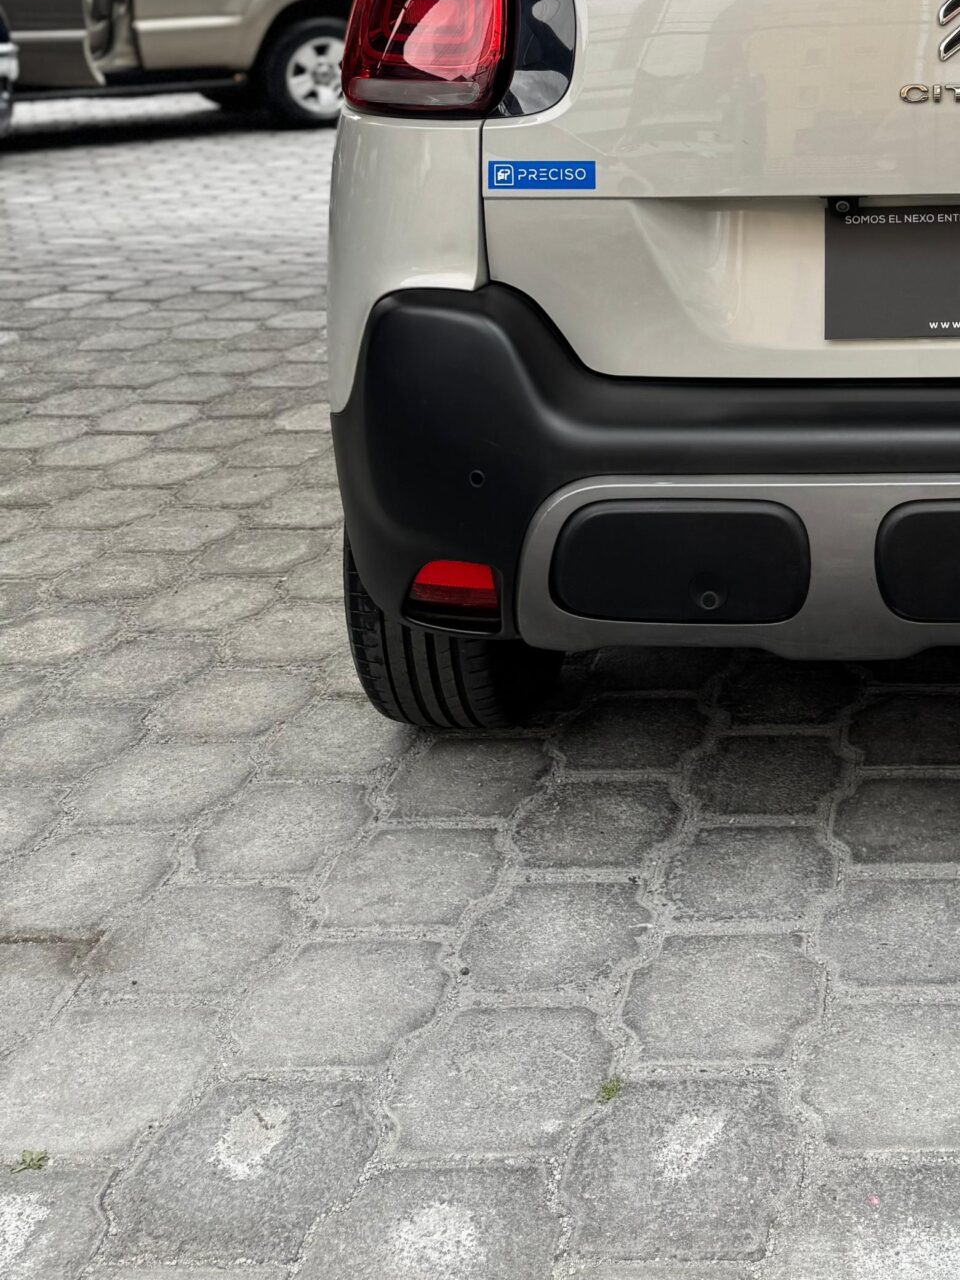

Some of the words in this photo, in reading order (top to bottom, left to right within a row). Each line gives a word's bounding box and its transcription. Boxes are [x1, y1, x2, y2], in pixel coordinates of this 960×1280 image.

[517, 167, 587, 181] PRECISO
[844, 214, 886, 225] SOMOS
[888, 214, 902, 224] EL
[904, 213, 935, 223] NEXO
